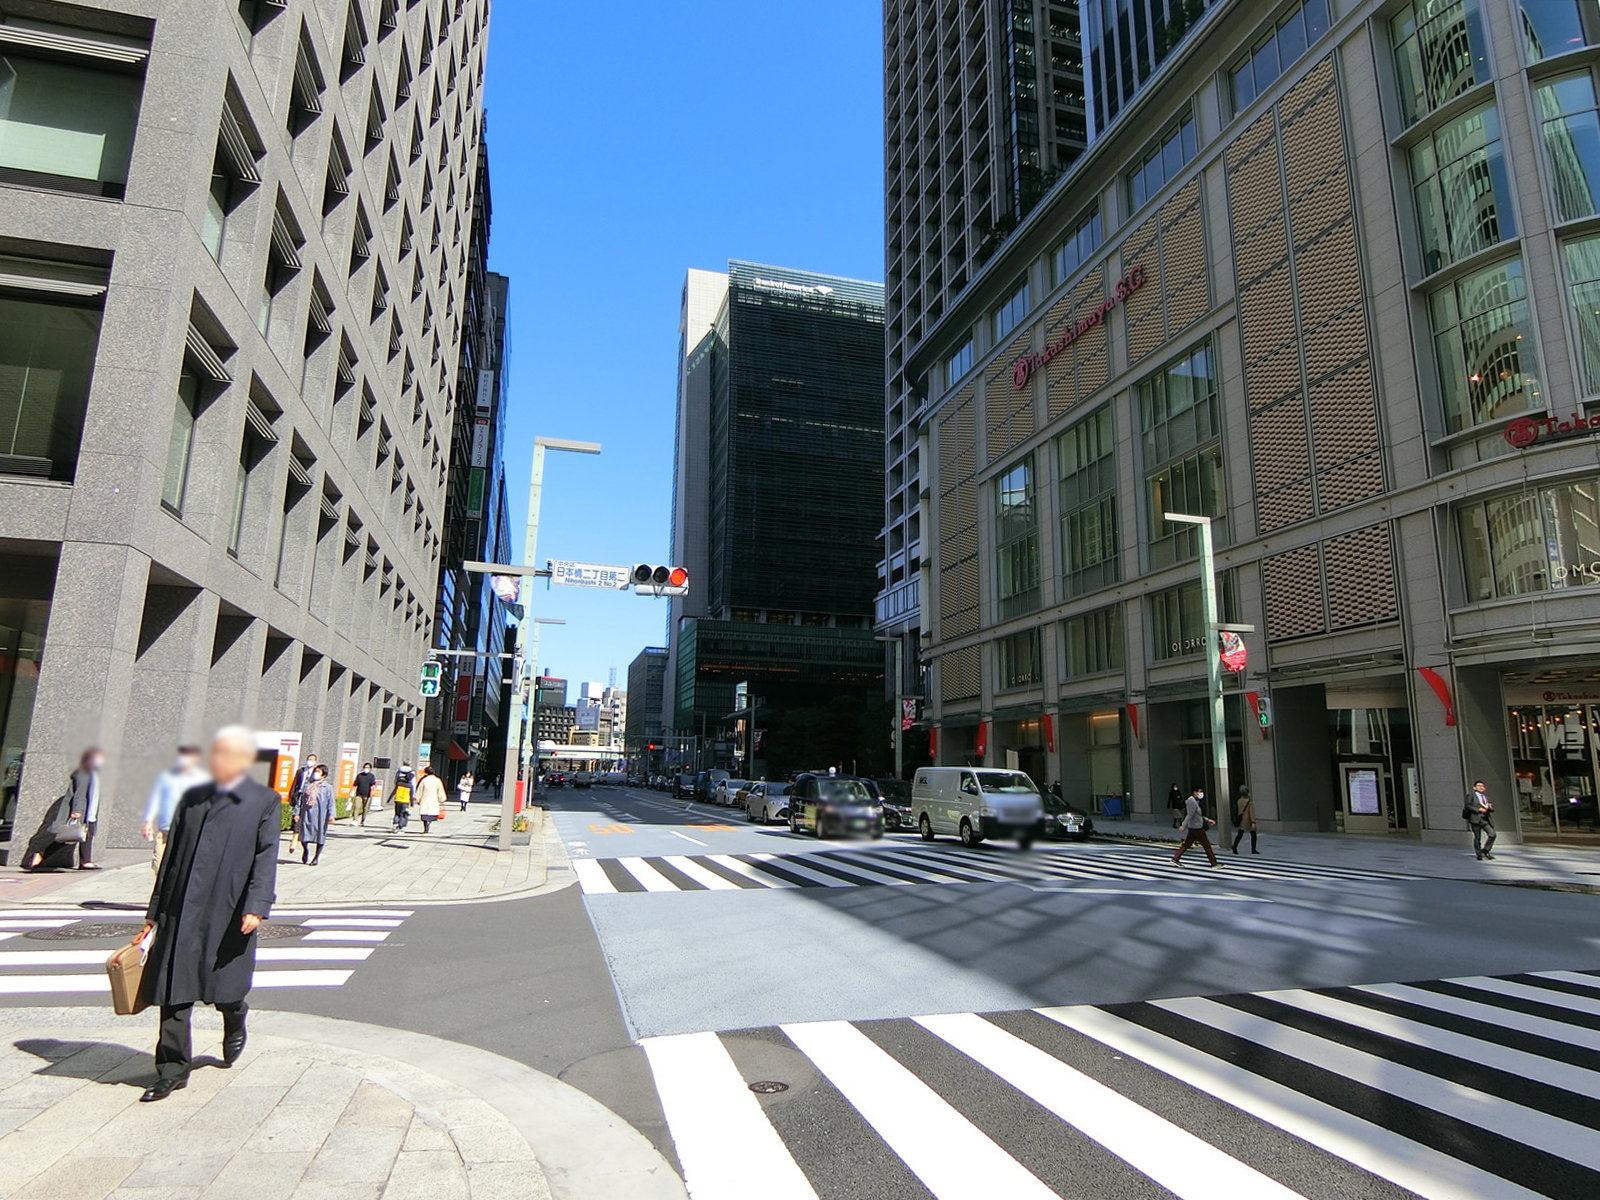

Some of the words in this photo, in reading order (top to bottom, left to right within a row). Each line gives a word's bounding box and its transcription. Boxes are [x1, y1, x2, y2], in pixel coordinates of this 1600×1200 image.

[1027, 297, 1115, 373] Takashimaya
[556, 566, 626, 582] 日本橋二丁目第二
[565, 577, 596, 586] Nihonbashi
[588, 824, 635, 834] 50
